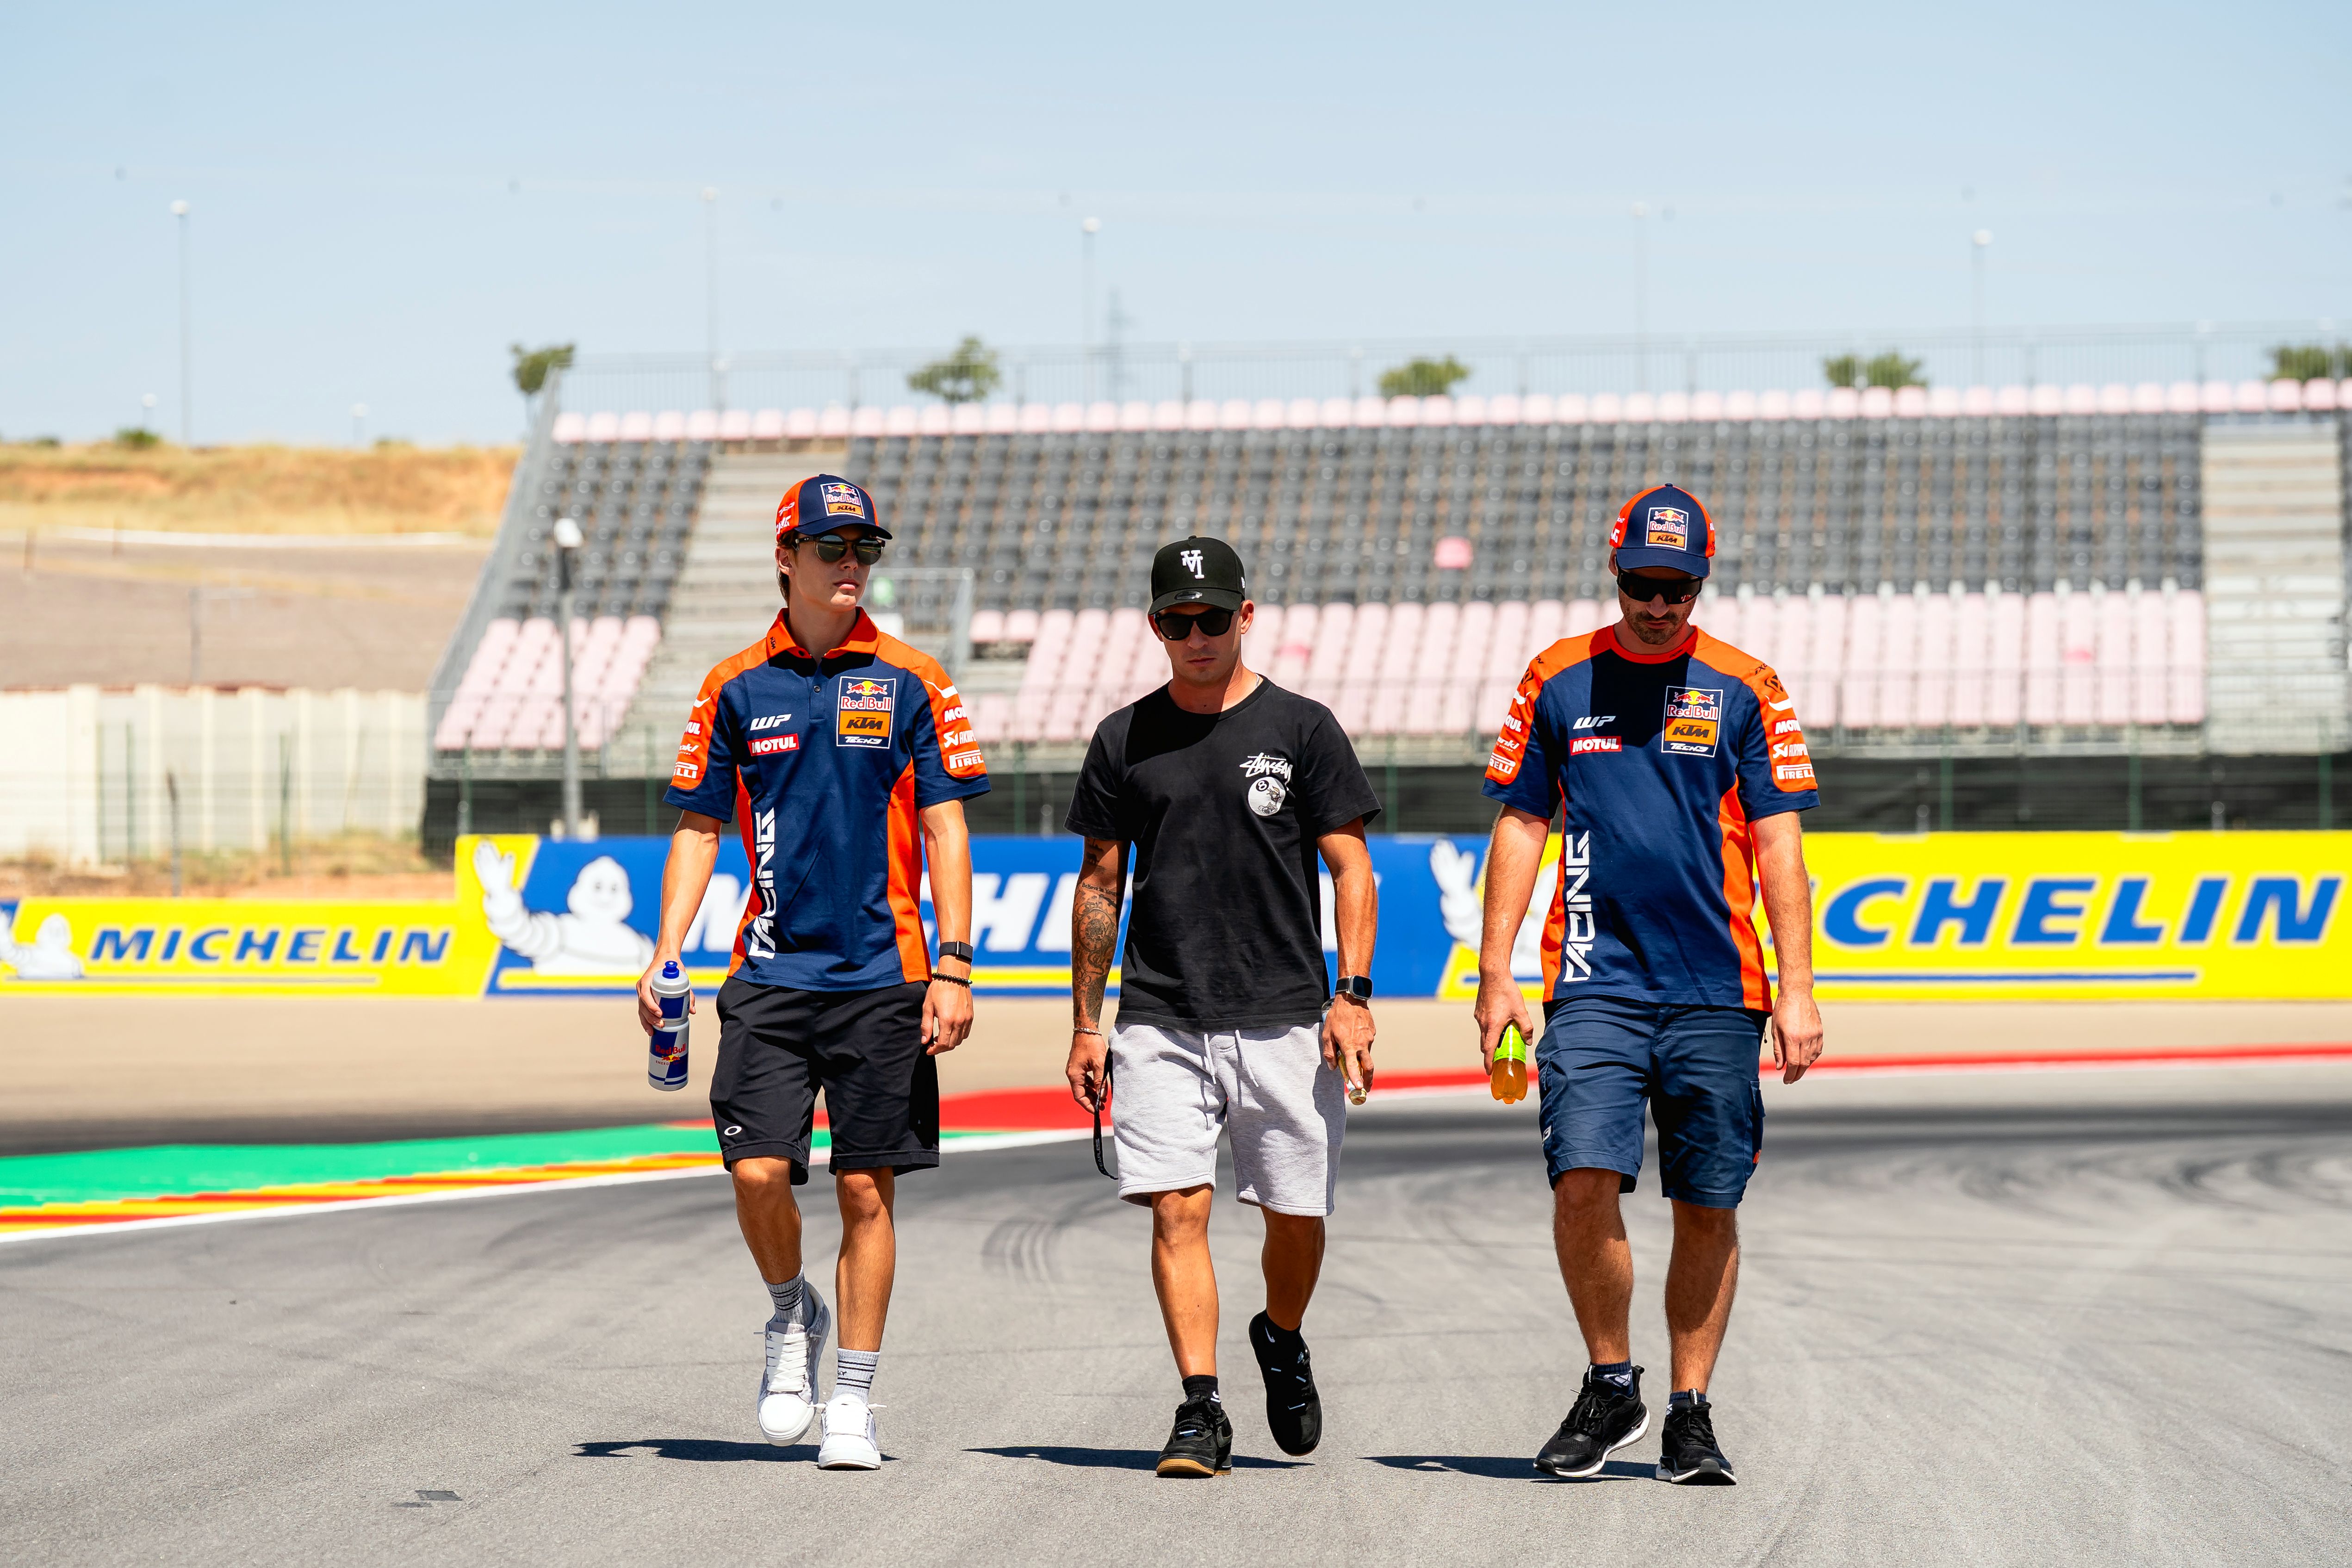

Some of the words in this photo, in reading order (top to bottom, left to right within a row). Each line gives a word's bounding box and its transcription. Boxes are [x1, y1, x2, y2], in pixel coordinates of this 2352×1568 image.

[1649, 521, 1669, 531] Red
[1669, 521, 1685, 535] Bull
[1656, 534, 1677, 543] KTM
[841, 696, 866, 710] Red
[867, 696, 891, 711] Bull
[1667, 705, 1693, 718] Red
[1693, 705, 1719, 720] Bull
[846, 717, 883, 730] KTM
[1672, 725, 1710, 738] KTM
[752, 736, 796, 753] MOTUL
[1572, 738, 1619, 753] MOTUL
[949, 749, 984, 769] PIREL
[1776, 763, 1814, 780] PIRELL
[1258, 780, 1267, 791] 8
[1756, 877, 2341, 945] CHELIN
[91, 929, 450, 963] MICHELIN
[655, 1044, 671, 1054] Red
[672, 1043, 686, 1054] Bull
